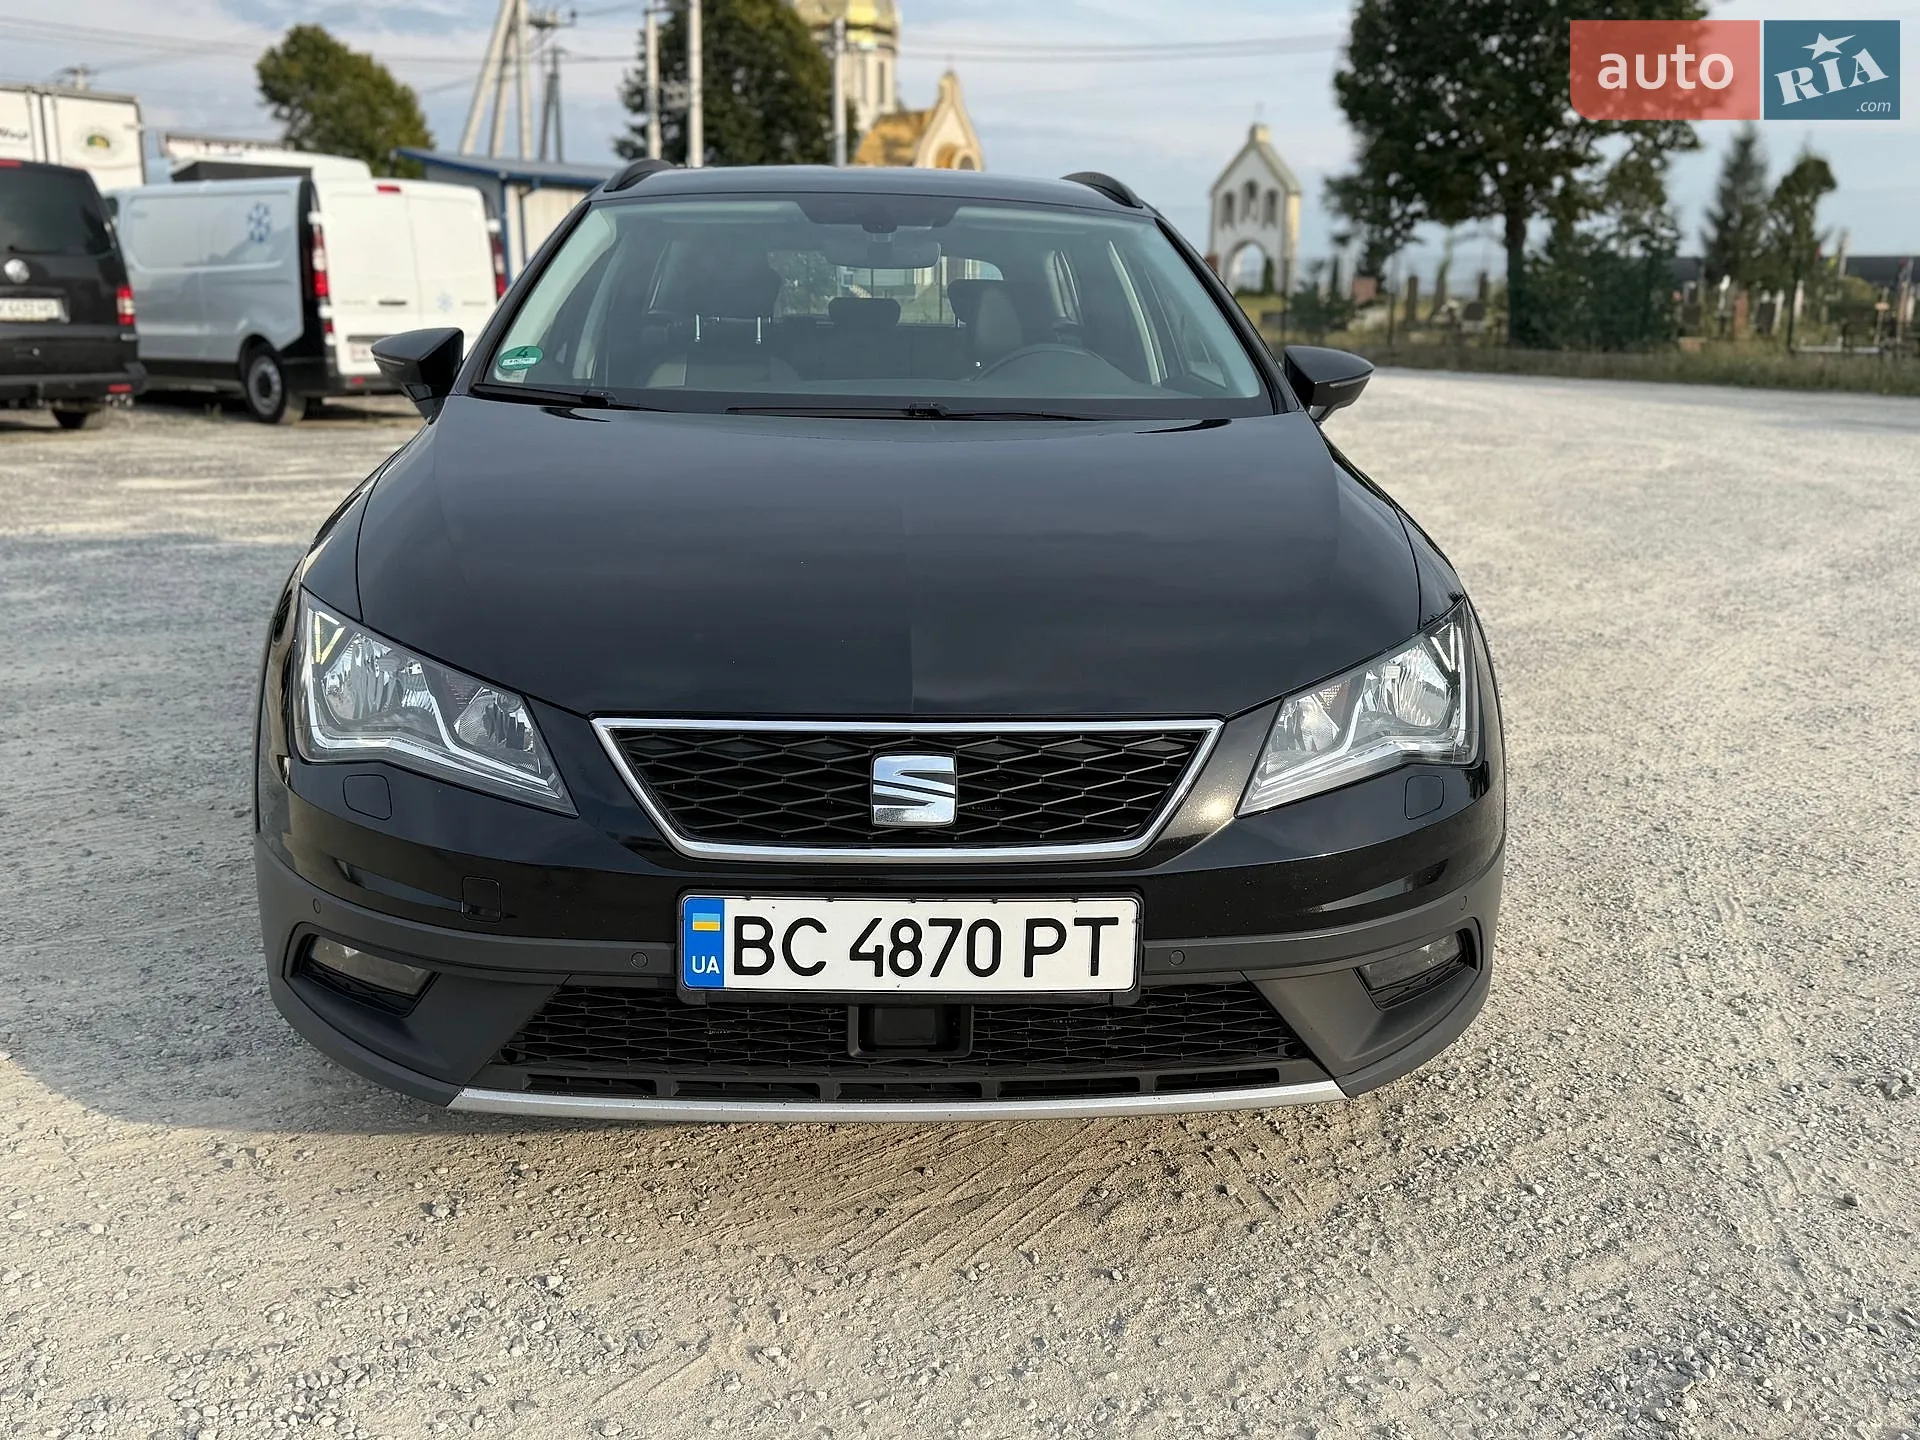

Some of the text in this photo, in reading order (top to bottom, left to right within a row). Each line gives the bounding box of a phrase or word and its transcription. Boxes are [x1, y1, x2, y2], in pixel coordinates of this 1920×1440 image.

[691, 954, 721, 975] UA
[733, 915, 1119, 978] BC 4870 PT
